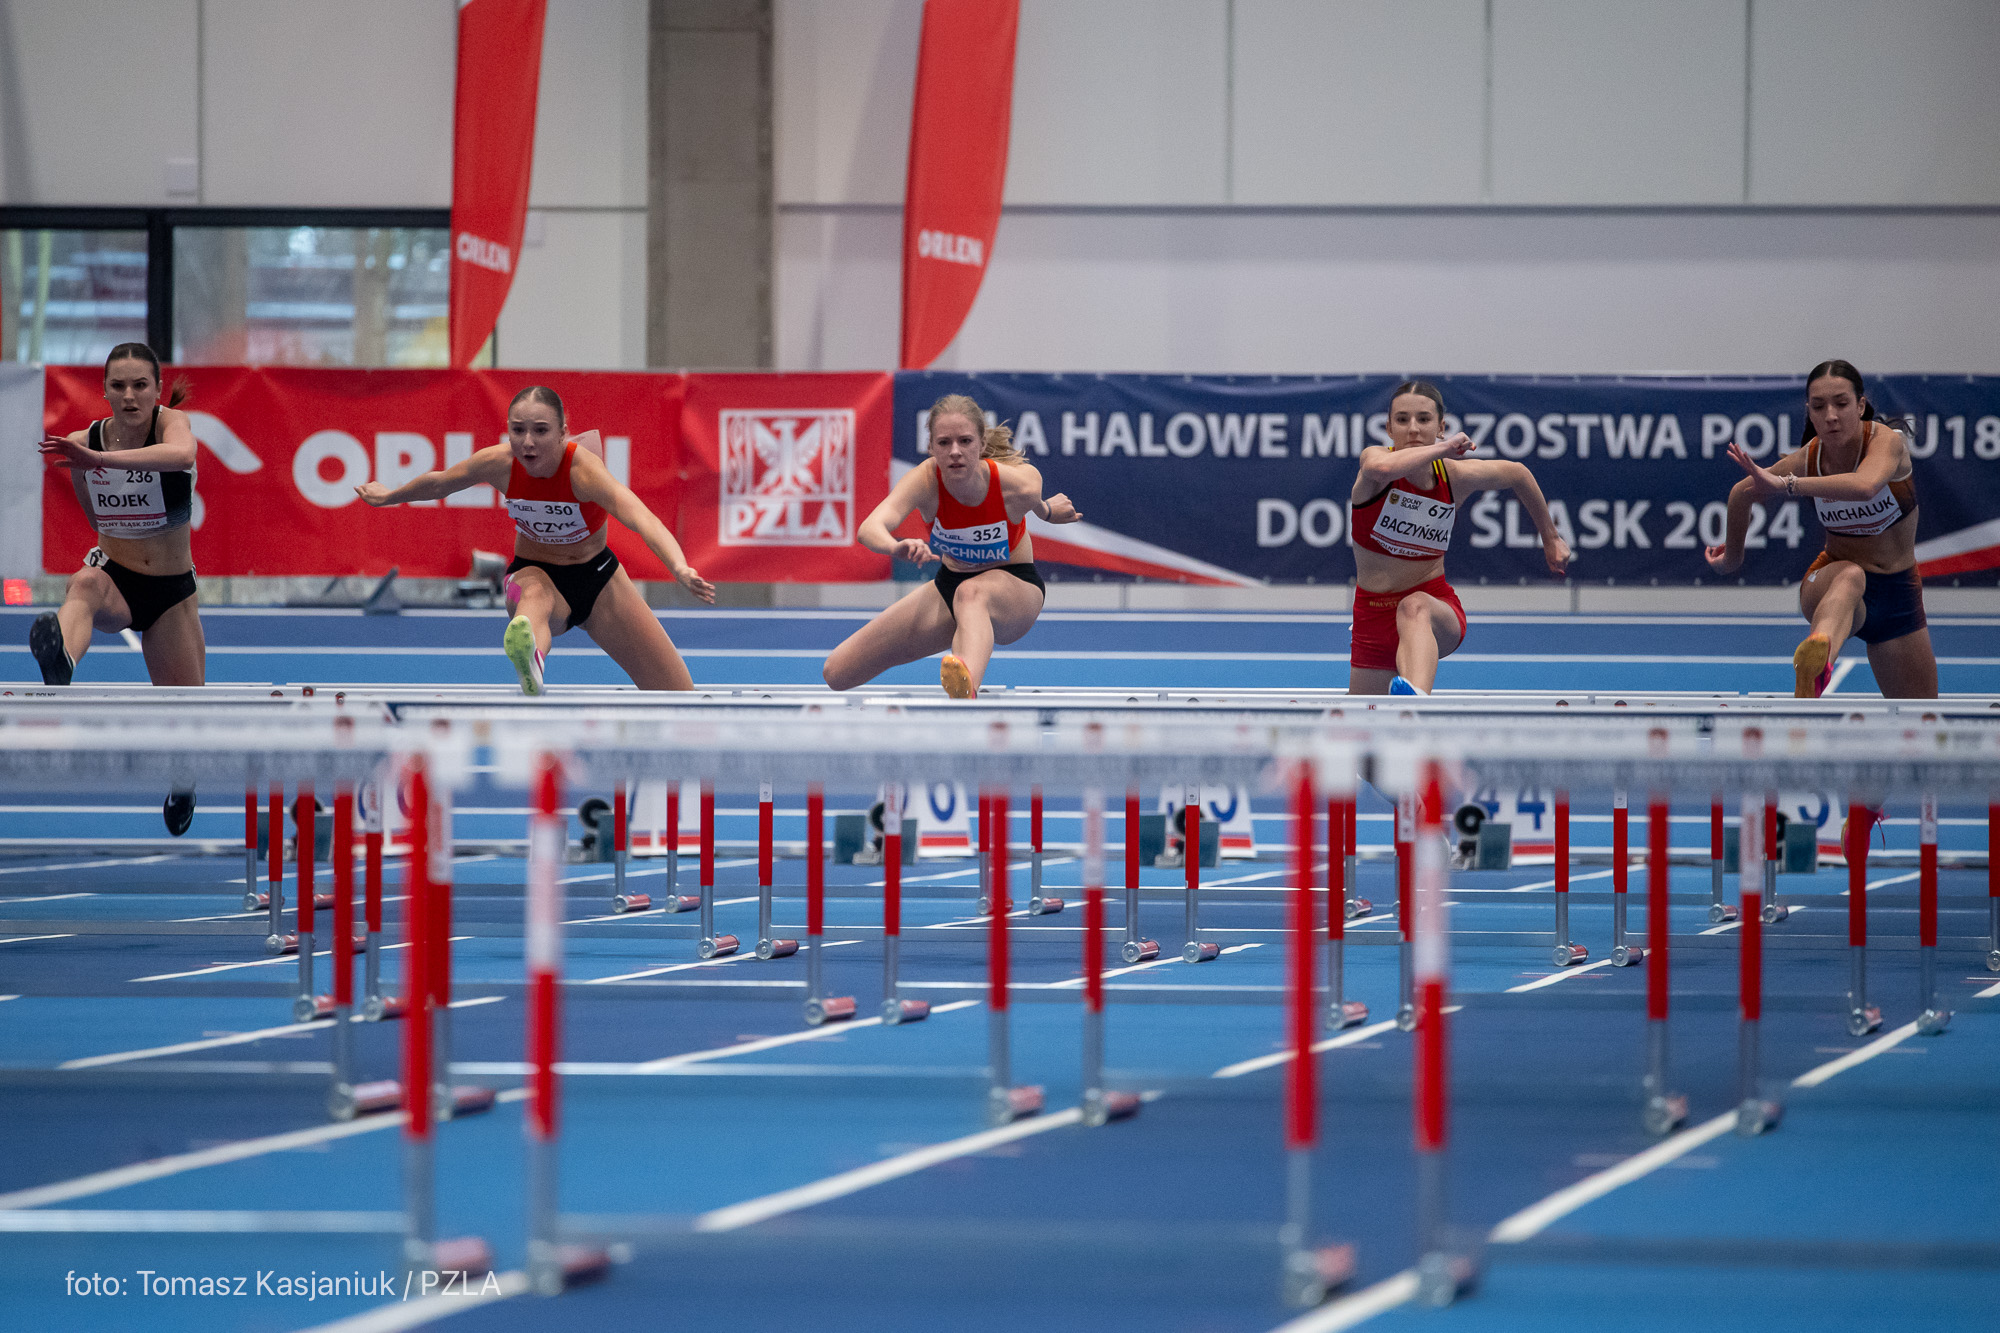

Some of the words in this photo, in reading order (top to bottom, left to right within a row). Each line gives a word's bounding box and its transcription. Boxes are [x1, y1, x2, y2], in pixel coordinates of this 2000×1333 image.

[456, 231, 511, 274] ORLEN
[918, 228, 983, 267] ORLEN
[1061, 411, 1289, 459] HALOWE
[1300, 412, 1688, 460] MISZOSTWA
[1903, 413, 2000, 460] U18
[125, 469, 153, 484] 236
[97, 493, 150, 508] ROJEK
[544, 504, 573, 516] 350
[1820, 495, 1895, 523] MICHALUK
[728, 501, 845, 538] PZLA
[1380, 515, 1449, 543] BACZYŃSKA
[1664, 499, 1805, 550] 2024
[972, 526, 1001, 542] 352
[932, 540, 1007, 560] ZOCHNIAK
